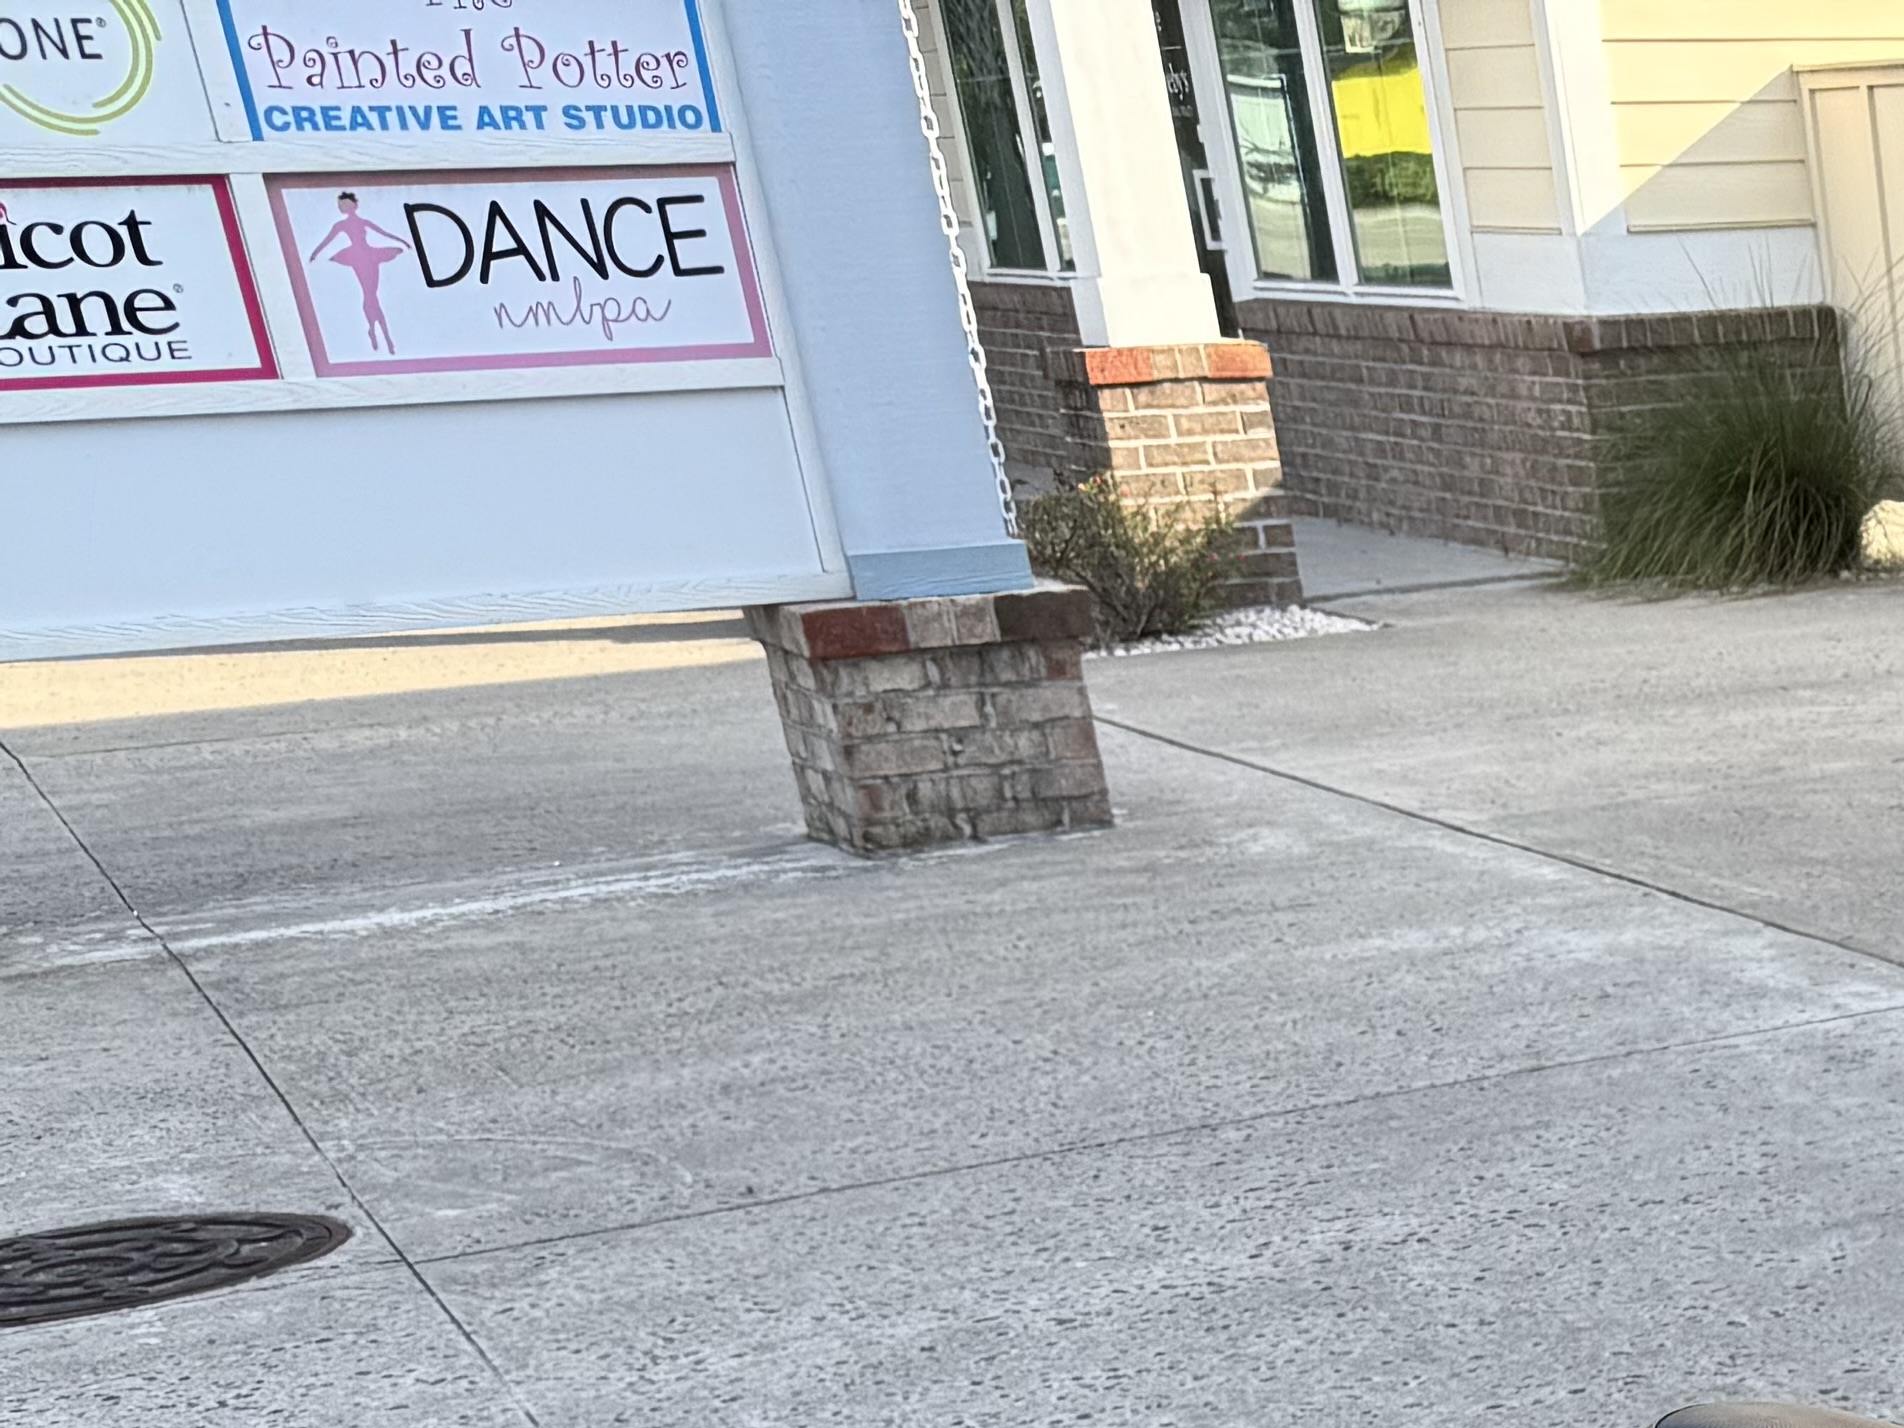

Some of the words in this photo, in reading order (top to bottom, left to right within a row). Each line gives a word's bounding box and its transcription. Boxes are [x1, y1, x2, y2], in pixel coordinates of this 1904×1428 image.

[247, 25, 482, 90] Painted
[500, 27, 689, 90] Potter
[263, 104, 464, 132] CREATIVE
[476, 104, 549, 131] ART
[562, 103, 704, 131] STUDIO
[404, 194, 725, 288] DANCE
